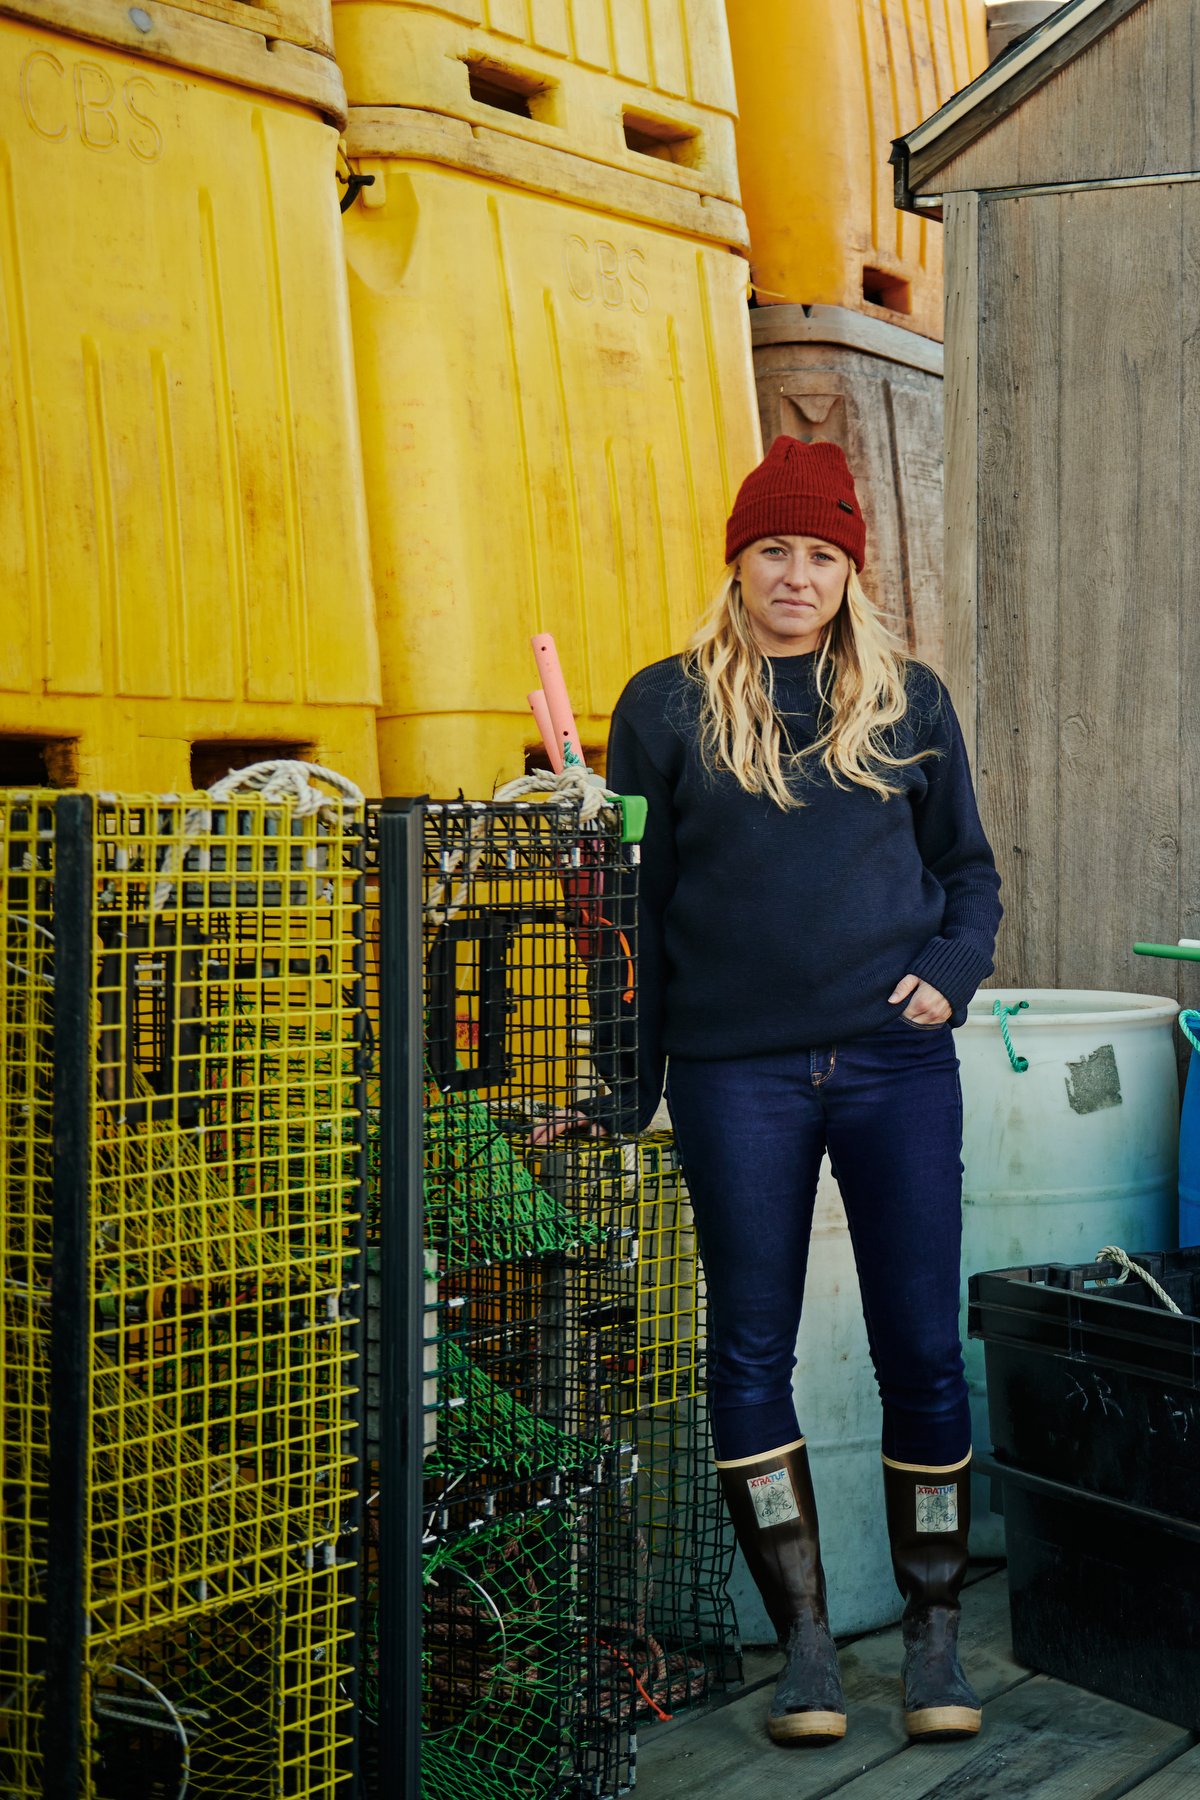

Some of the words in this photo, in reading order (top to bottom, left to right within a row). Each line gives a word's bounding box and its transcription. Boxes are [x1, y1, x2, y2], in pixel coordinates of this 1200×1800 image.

[20, 50, 163, 164] CBS
[564, 233, 650, 316] CBS
[751, 1471, 785, 1488] XTRATUF
[918, 1485, 955, 1495] XTRATUF
